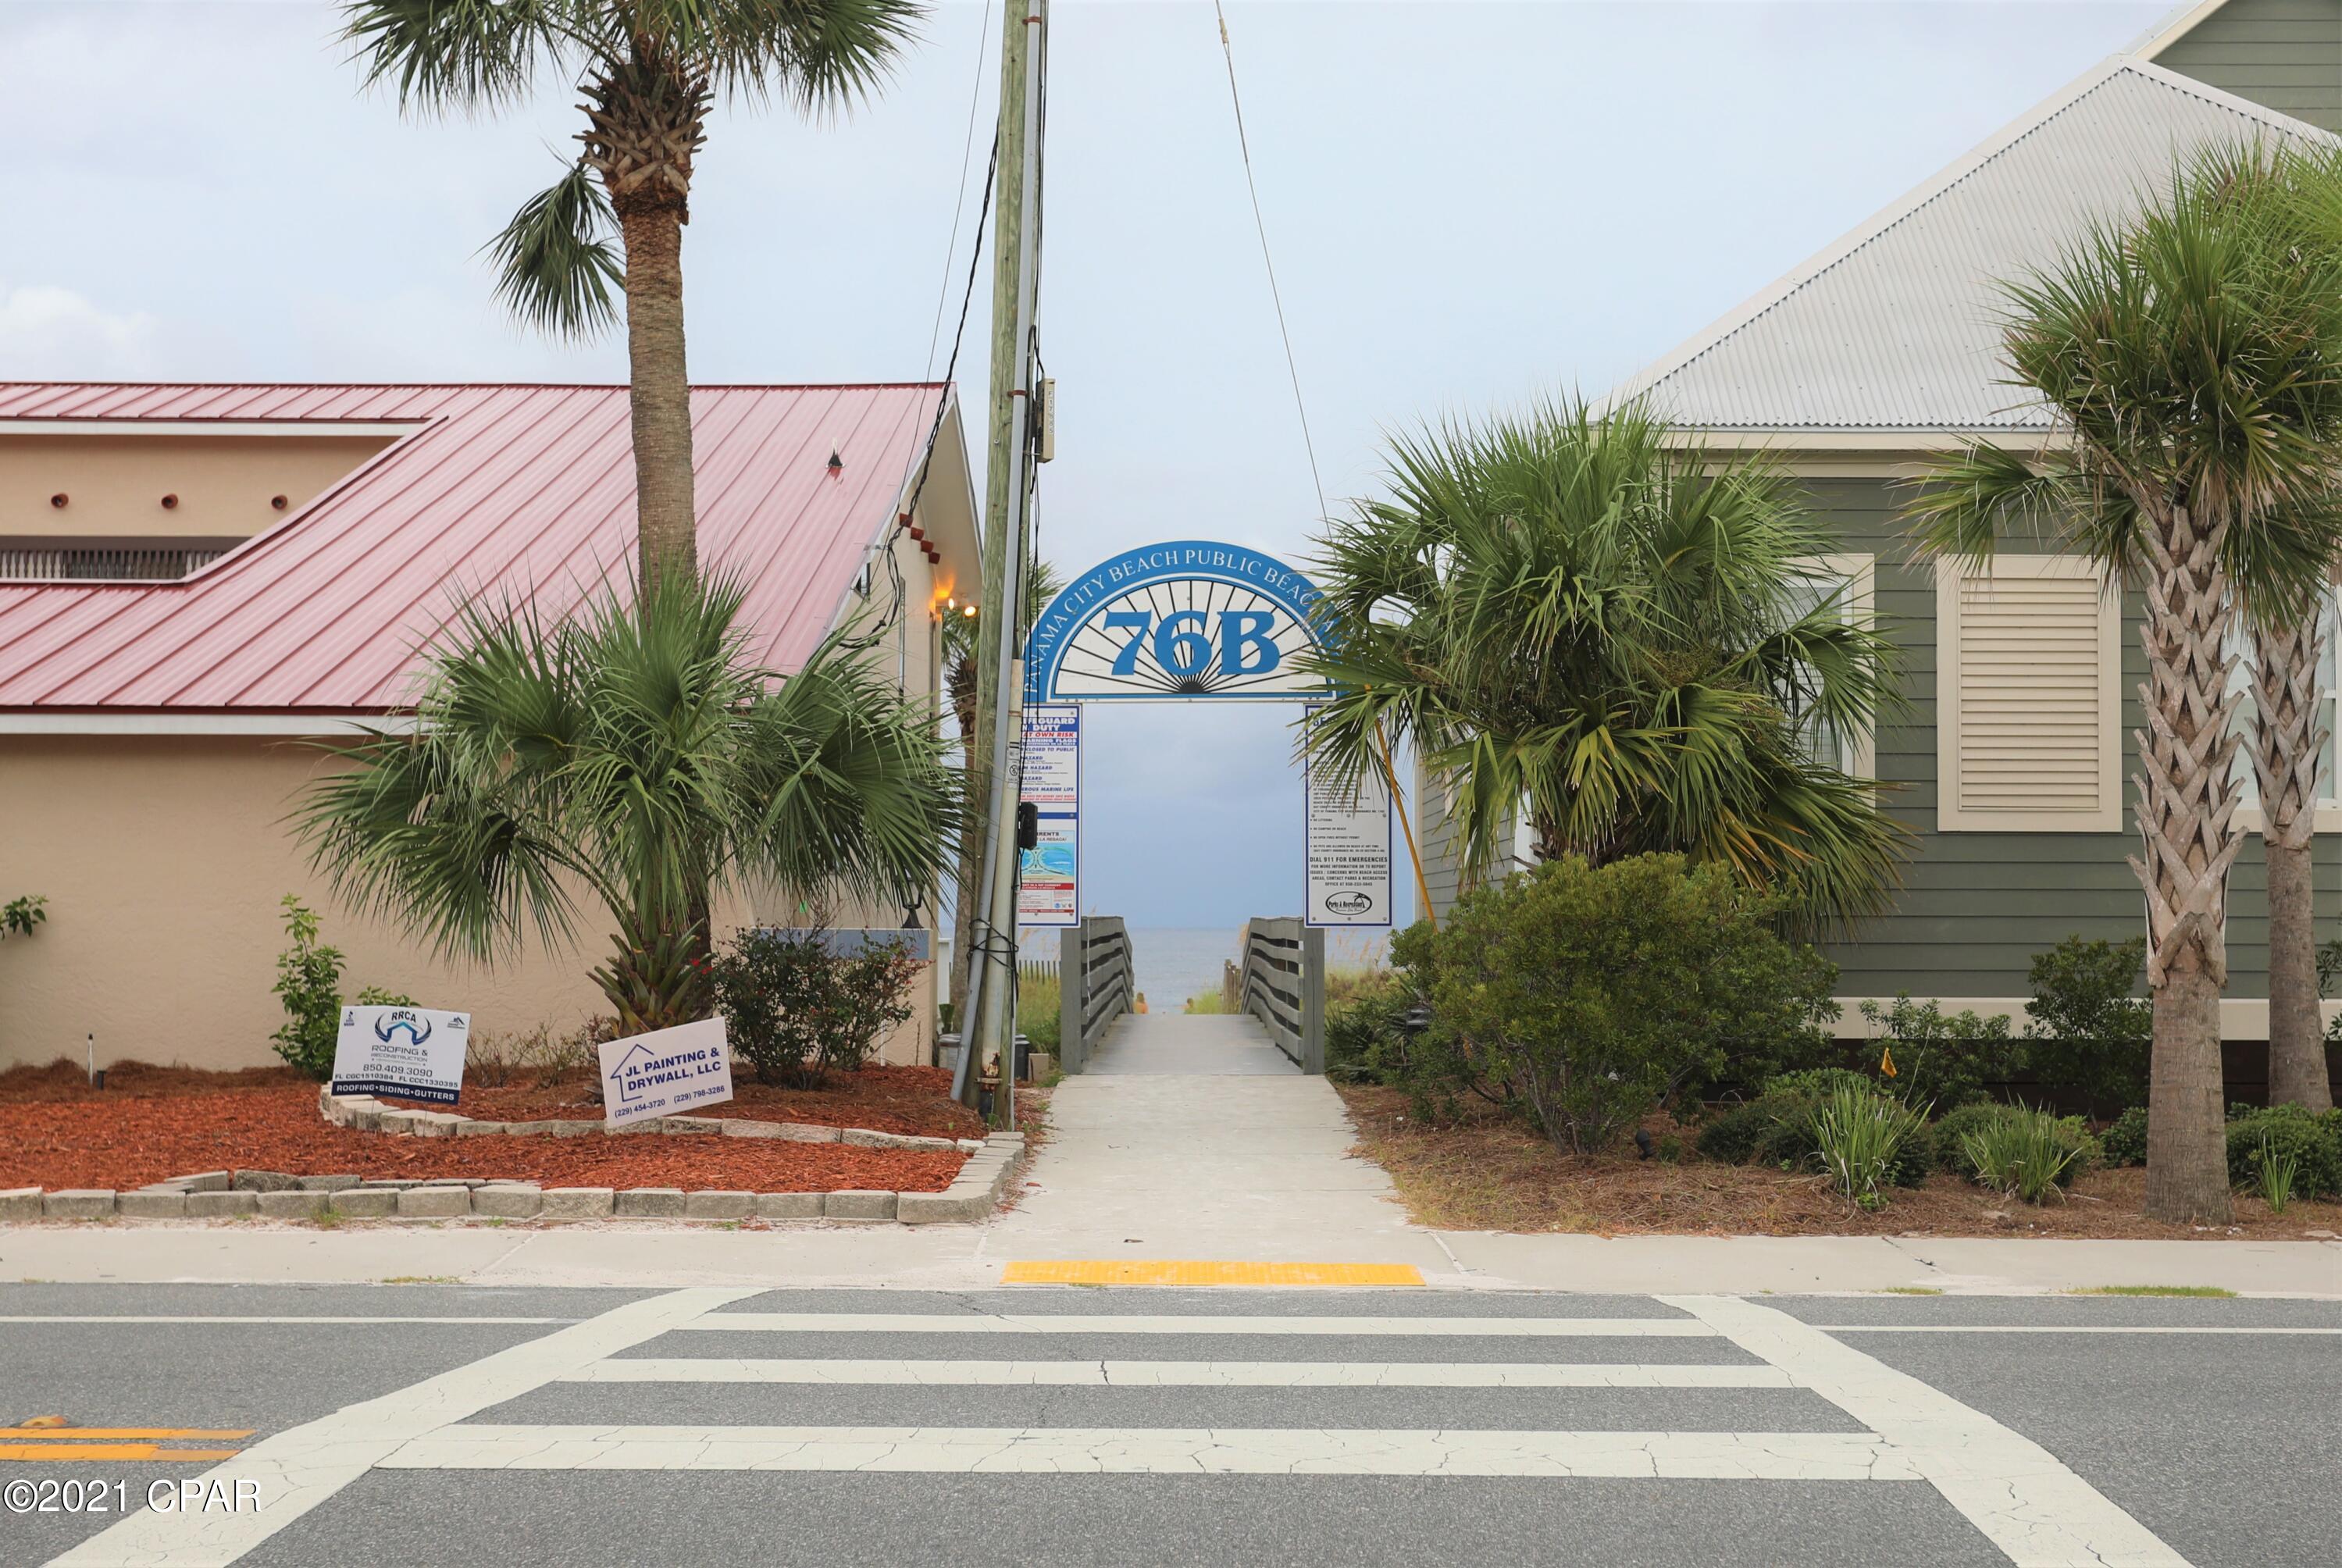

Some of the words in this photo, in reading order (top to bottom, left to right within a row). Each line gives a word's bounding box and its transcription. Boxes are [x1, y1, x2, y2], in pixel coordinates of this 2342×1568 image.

[1023, 614, 1069, 693] PANAMA
[1064, 574, 1105, 615] CITY
[1109, 552, 1179, 583] BEACH
[1185, 549, 1262, 576] PUBLIC
[1264, 566, 1320, 612] BEAC
[1102, 610, 1281, 676] 76B
[391, 1011, 417, 1023] RRCA
[370, 1053, 429, 1063] RECONSTRUCTION
[371, 1045, 419, 1056] ROOFING
[362, 1064, 433, 1078] 850.409.3090
[626, 1065, 641, 1078] JL
[643, 1049, 707, 1073] PAINTING
[710, 1047, 720, 1057] &
[627, 1068, 694, 1092] DRYWALL,
[697, 1061, 722, 1075] LLC
[673, 1093, 692, 1105] (229)
[693, 1085, 725, 1099] 798-3286
[615, 1107, 633, 1119] (229)
[633, 1099, 666, 1114] 454-3720
